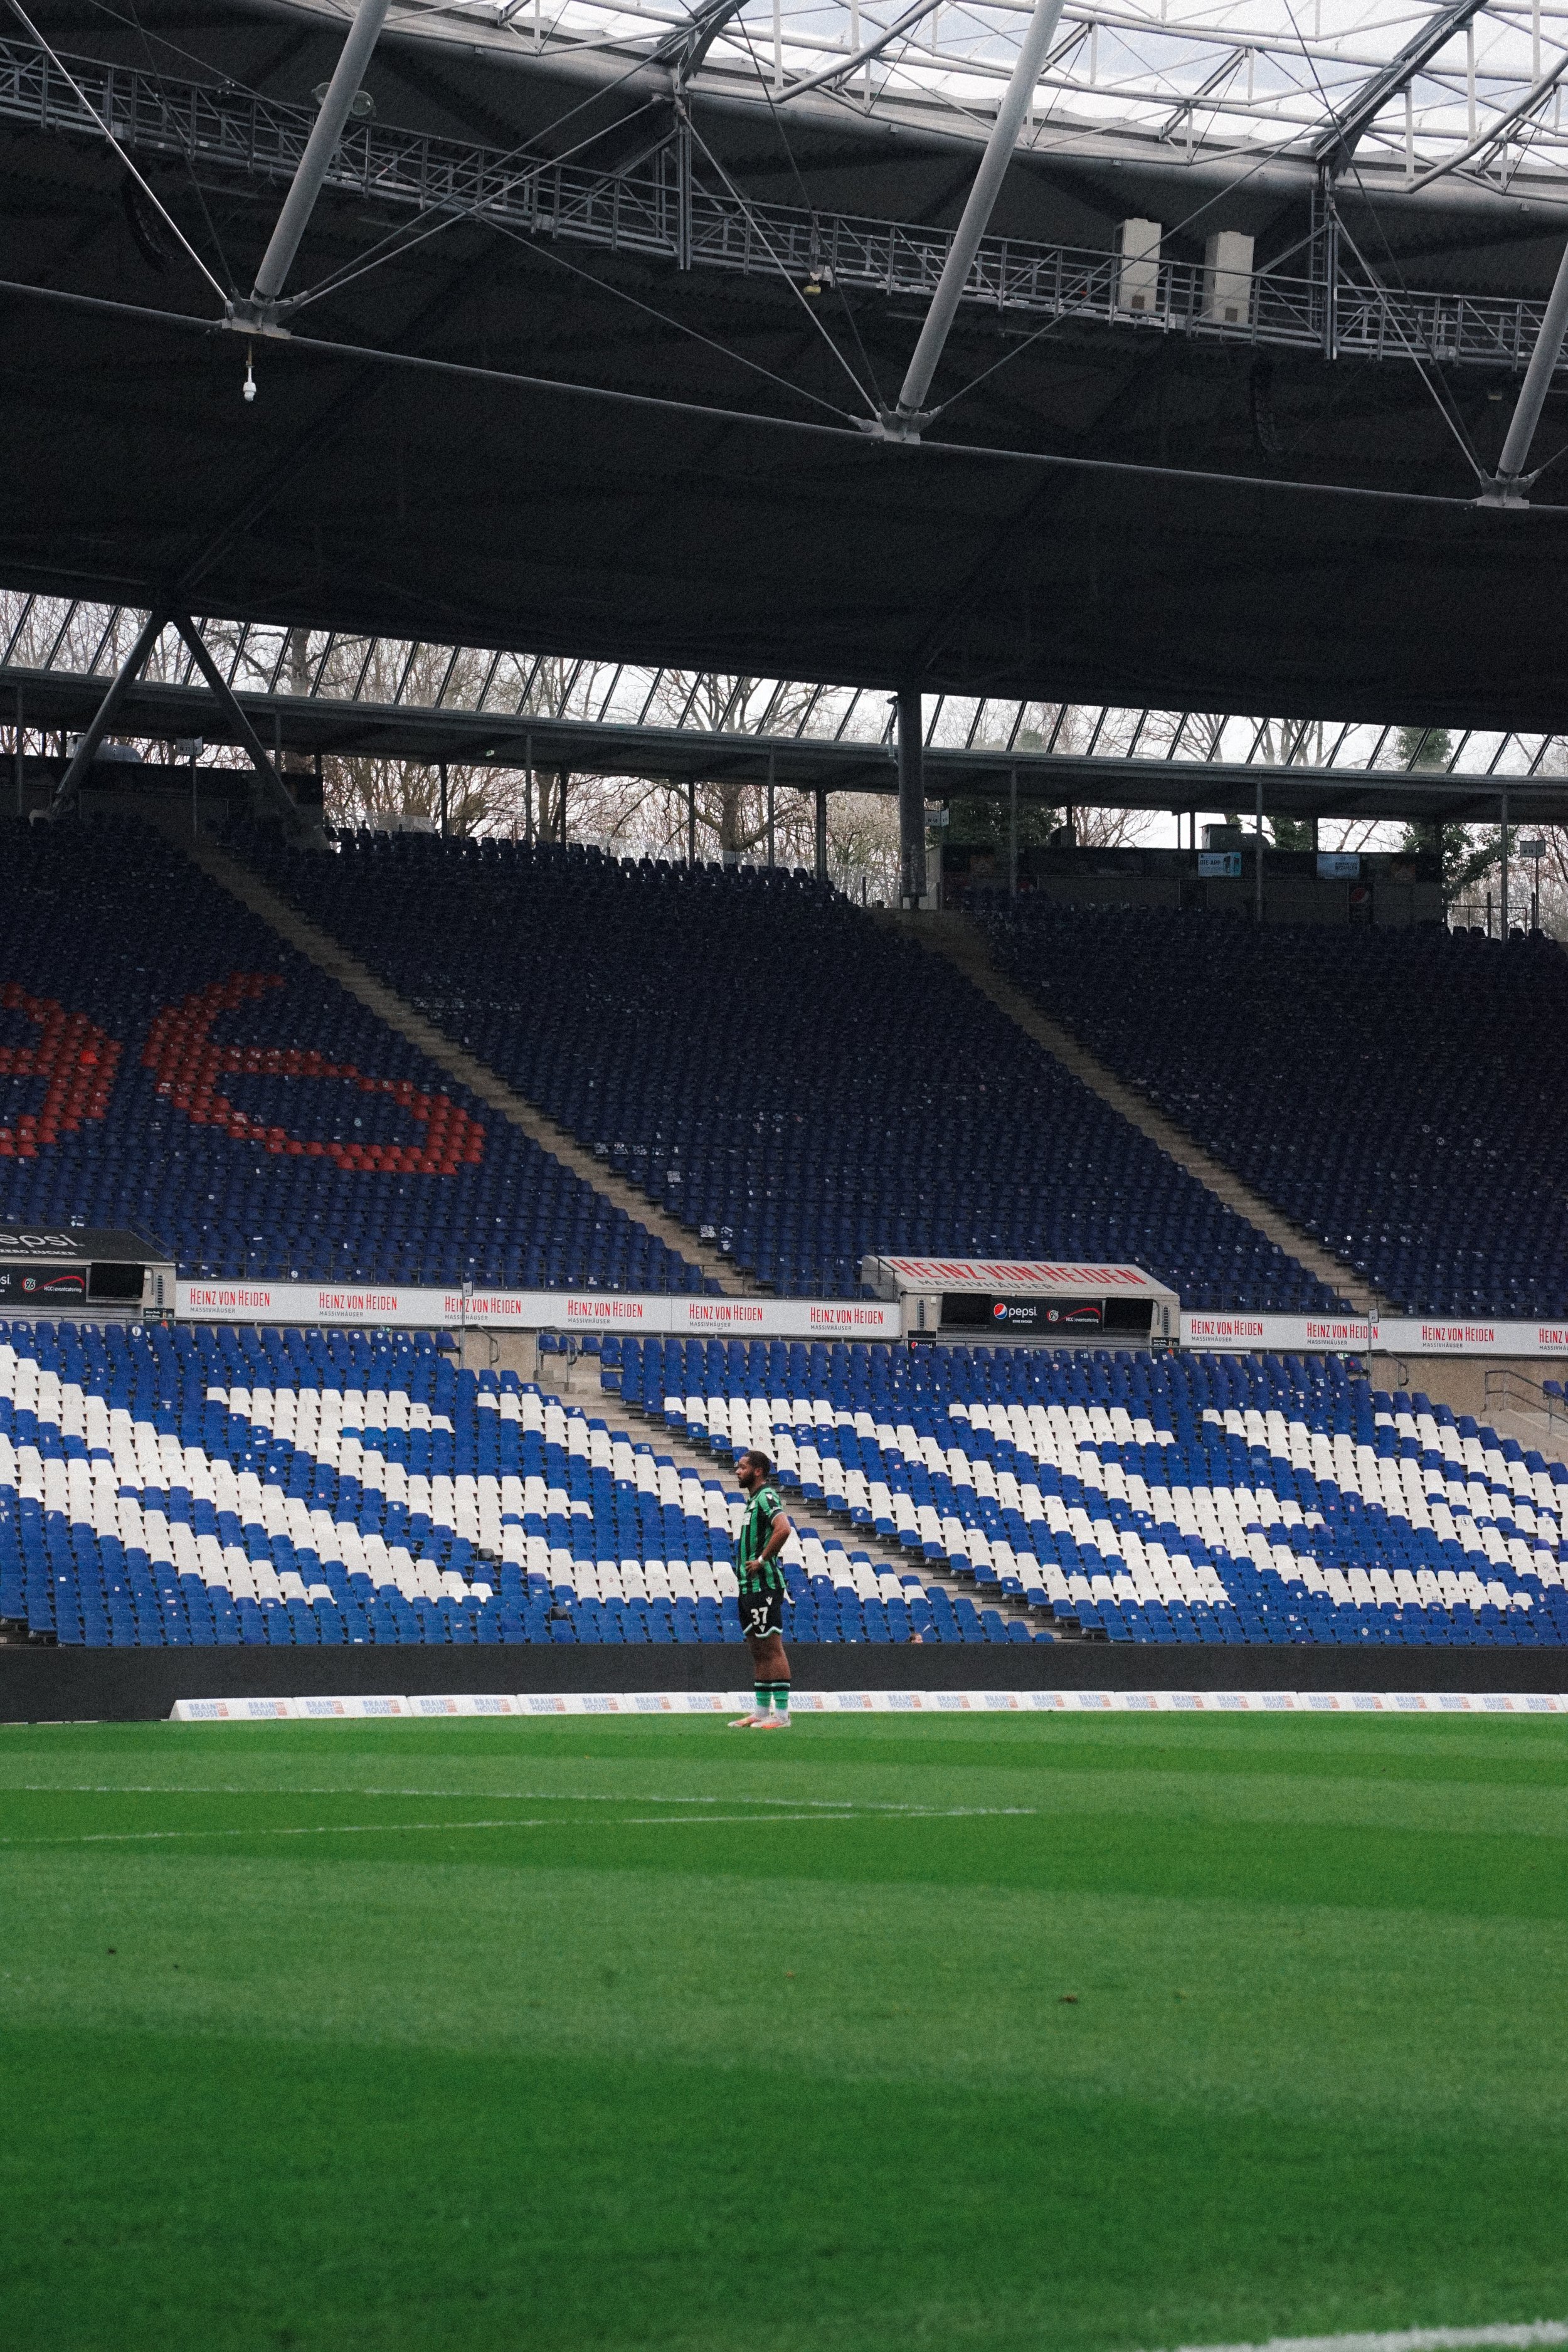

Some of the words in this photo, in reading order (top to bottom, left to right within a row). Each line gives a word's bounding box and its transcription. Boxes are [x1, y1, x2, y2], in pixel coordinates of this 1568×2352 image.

[0, 1234, 78, 1248] epsi
[890, 1258, 985, 1281] HEINZ
[977, 1264, 1043, 1283] VON
[1032, 1263, 1147, 1286] HEIDEN
[918, 1280, 1055, 1290] MASSIVHÄUSER
[191, 1288, 216, 1305] HEINZ
[218, 1291, 235, 1305] VON
[239, 1290, 270, 1306] HEIDEN
[320, 1292, 344, 1308] HEINZ
[347, 1295, 363, 1309] VON
[366, 1294, 396, 1310] HEIDEN
[472, 1300, 488, 1313] VON
[491, 1298, 521, 1313] HEIDEN
[568, 1300, 591, 1316] HEINZ
[595, 1303, 610, 1316] VON
[613, 1301, 642, 1317] HEIDEN
[690, 1303, 712, 1320] HEINZ
[716, 1306, 731, 1320] VON
[734, 1305, 762, 1320] HEIDEN
[1009, 1306, 1037, 1318] pepsi
[811, 1307, 834, 1323] HEINZ
[836, 1310, 851, 1323] VON
[854, 1308, 883, 1324] HEIDEN
[1192, 1319, 1214, 1334] HEINZ
[1217, 1322, 1232, 1335] VON
[1235, 1320, 1263, 1335] HEIDEN
[1308, 1322, 1330, 1337] HEINZ
[1332, 1325, 1347, 1338] VON
[1422, 1325, 1445, 1340] HEINZ
[1448, 1328, 1463, 1340] VON
[1466, 1327, 1494, 1341] HEIDEN
[1540, 1328, 1562, 1343] HEINZ
[751, 1606, 768, 1625] 37
